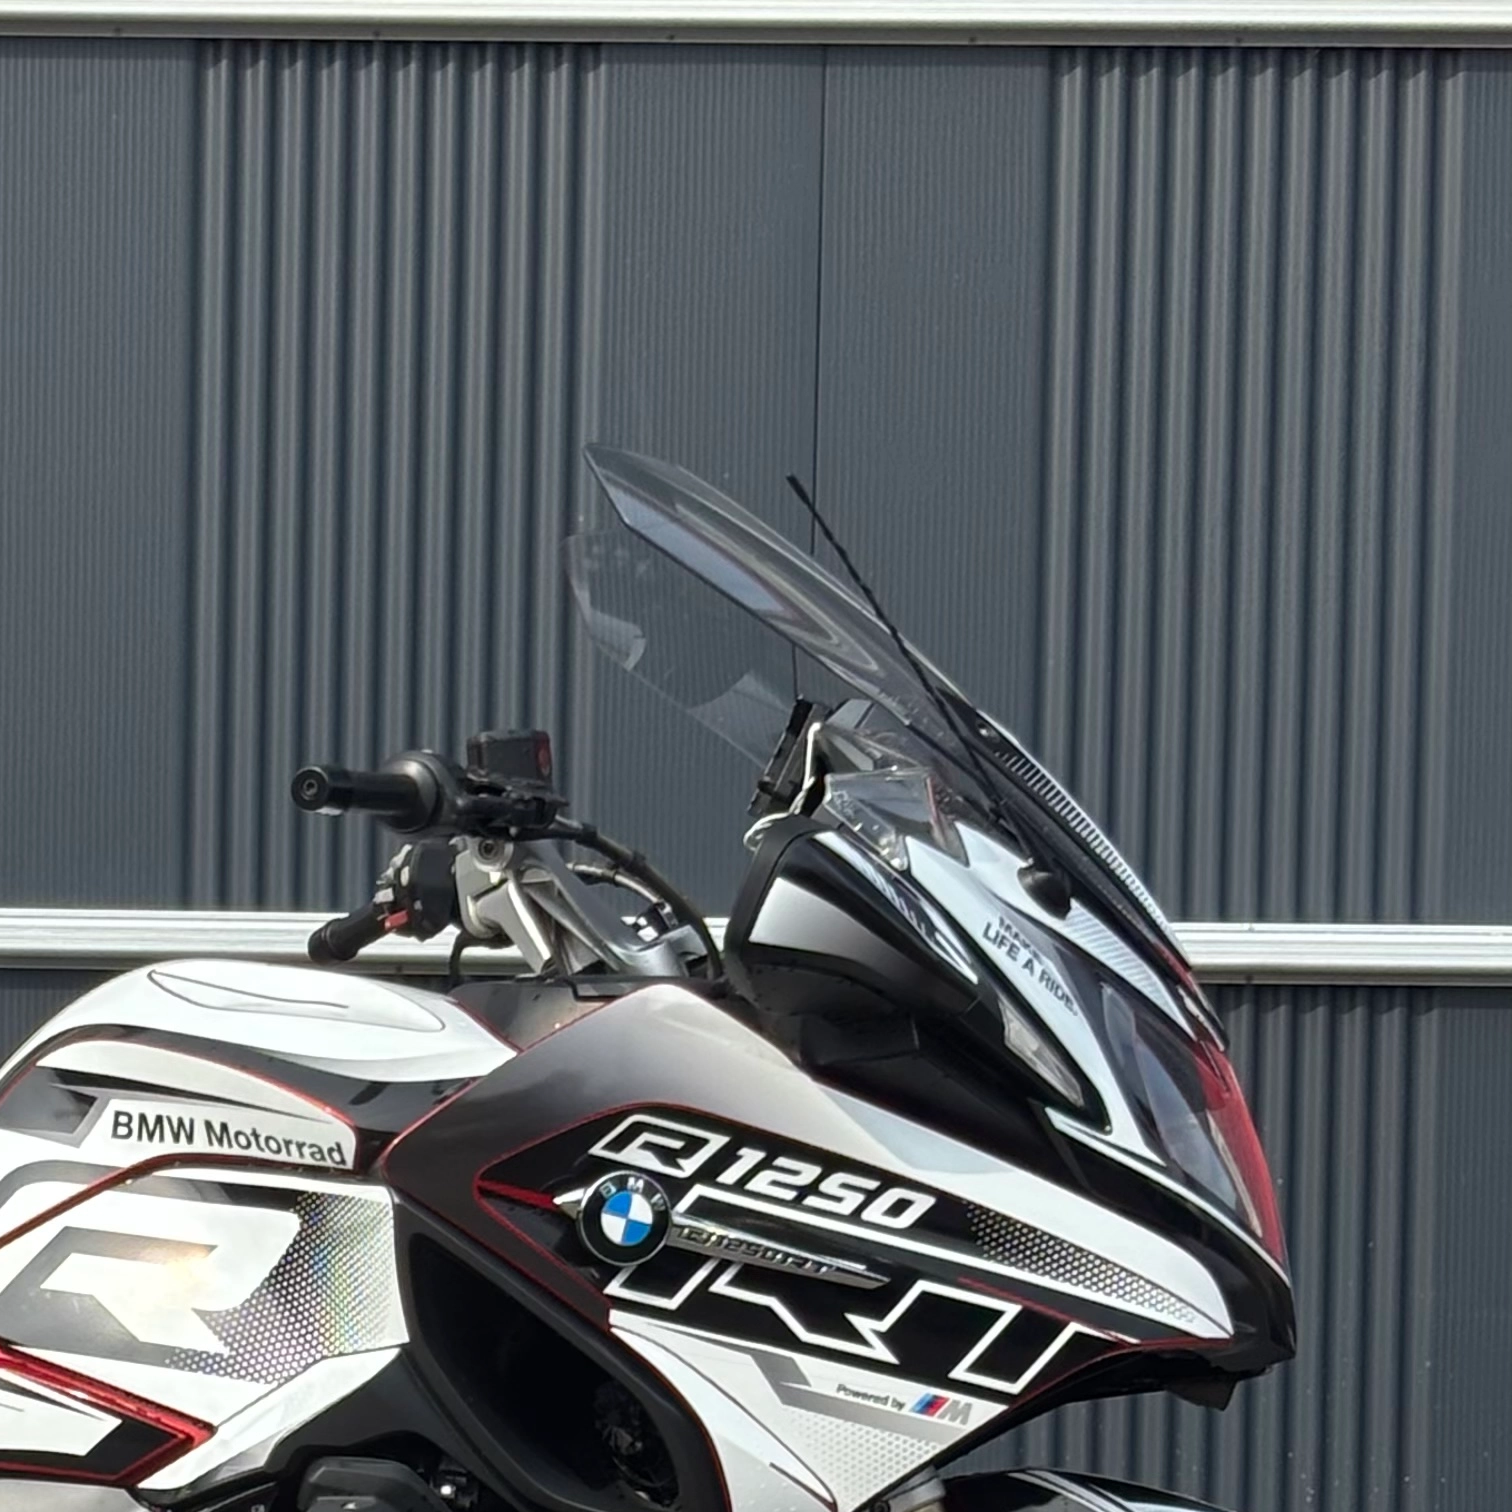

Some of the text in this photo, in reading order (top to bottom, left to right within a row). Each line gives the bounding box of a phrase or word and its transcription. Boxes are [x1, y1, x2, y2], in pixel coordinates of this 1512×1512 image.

[982, 921, 1020, 962] LIFE
[1021, 959, 1036, 977] A
[110, 1111, 347, 1168] BMW Motorrad
[598, 1176, 667, 1213] BMW
[836, 1383, 890, 1408] Powered
[891, 1397, 906, 1412] by
